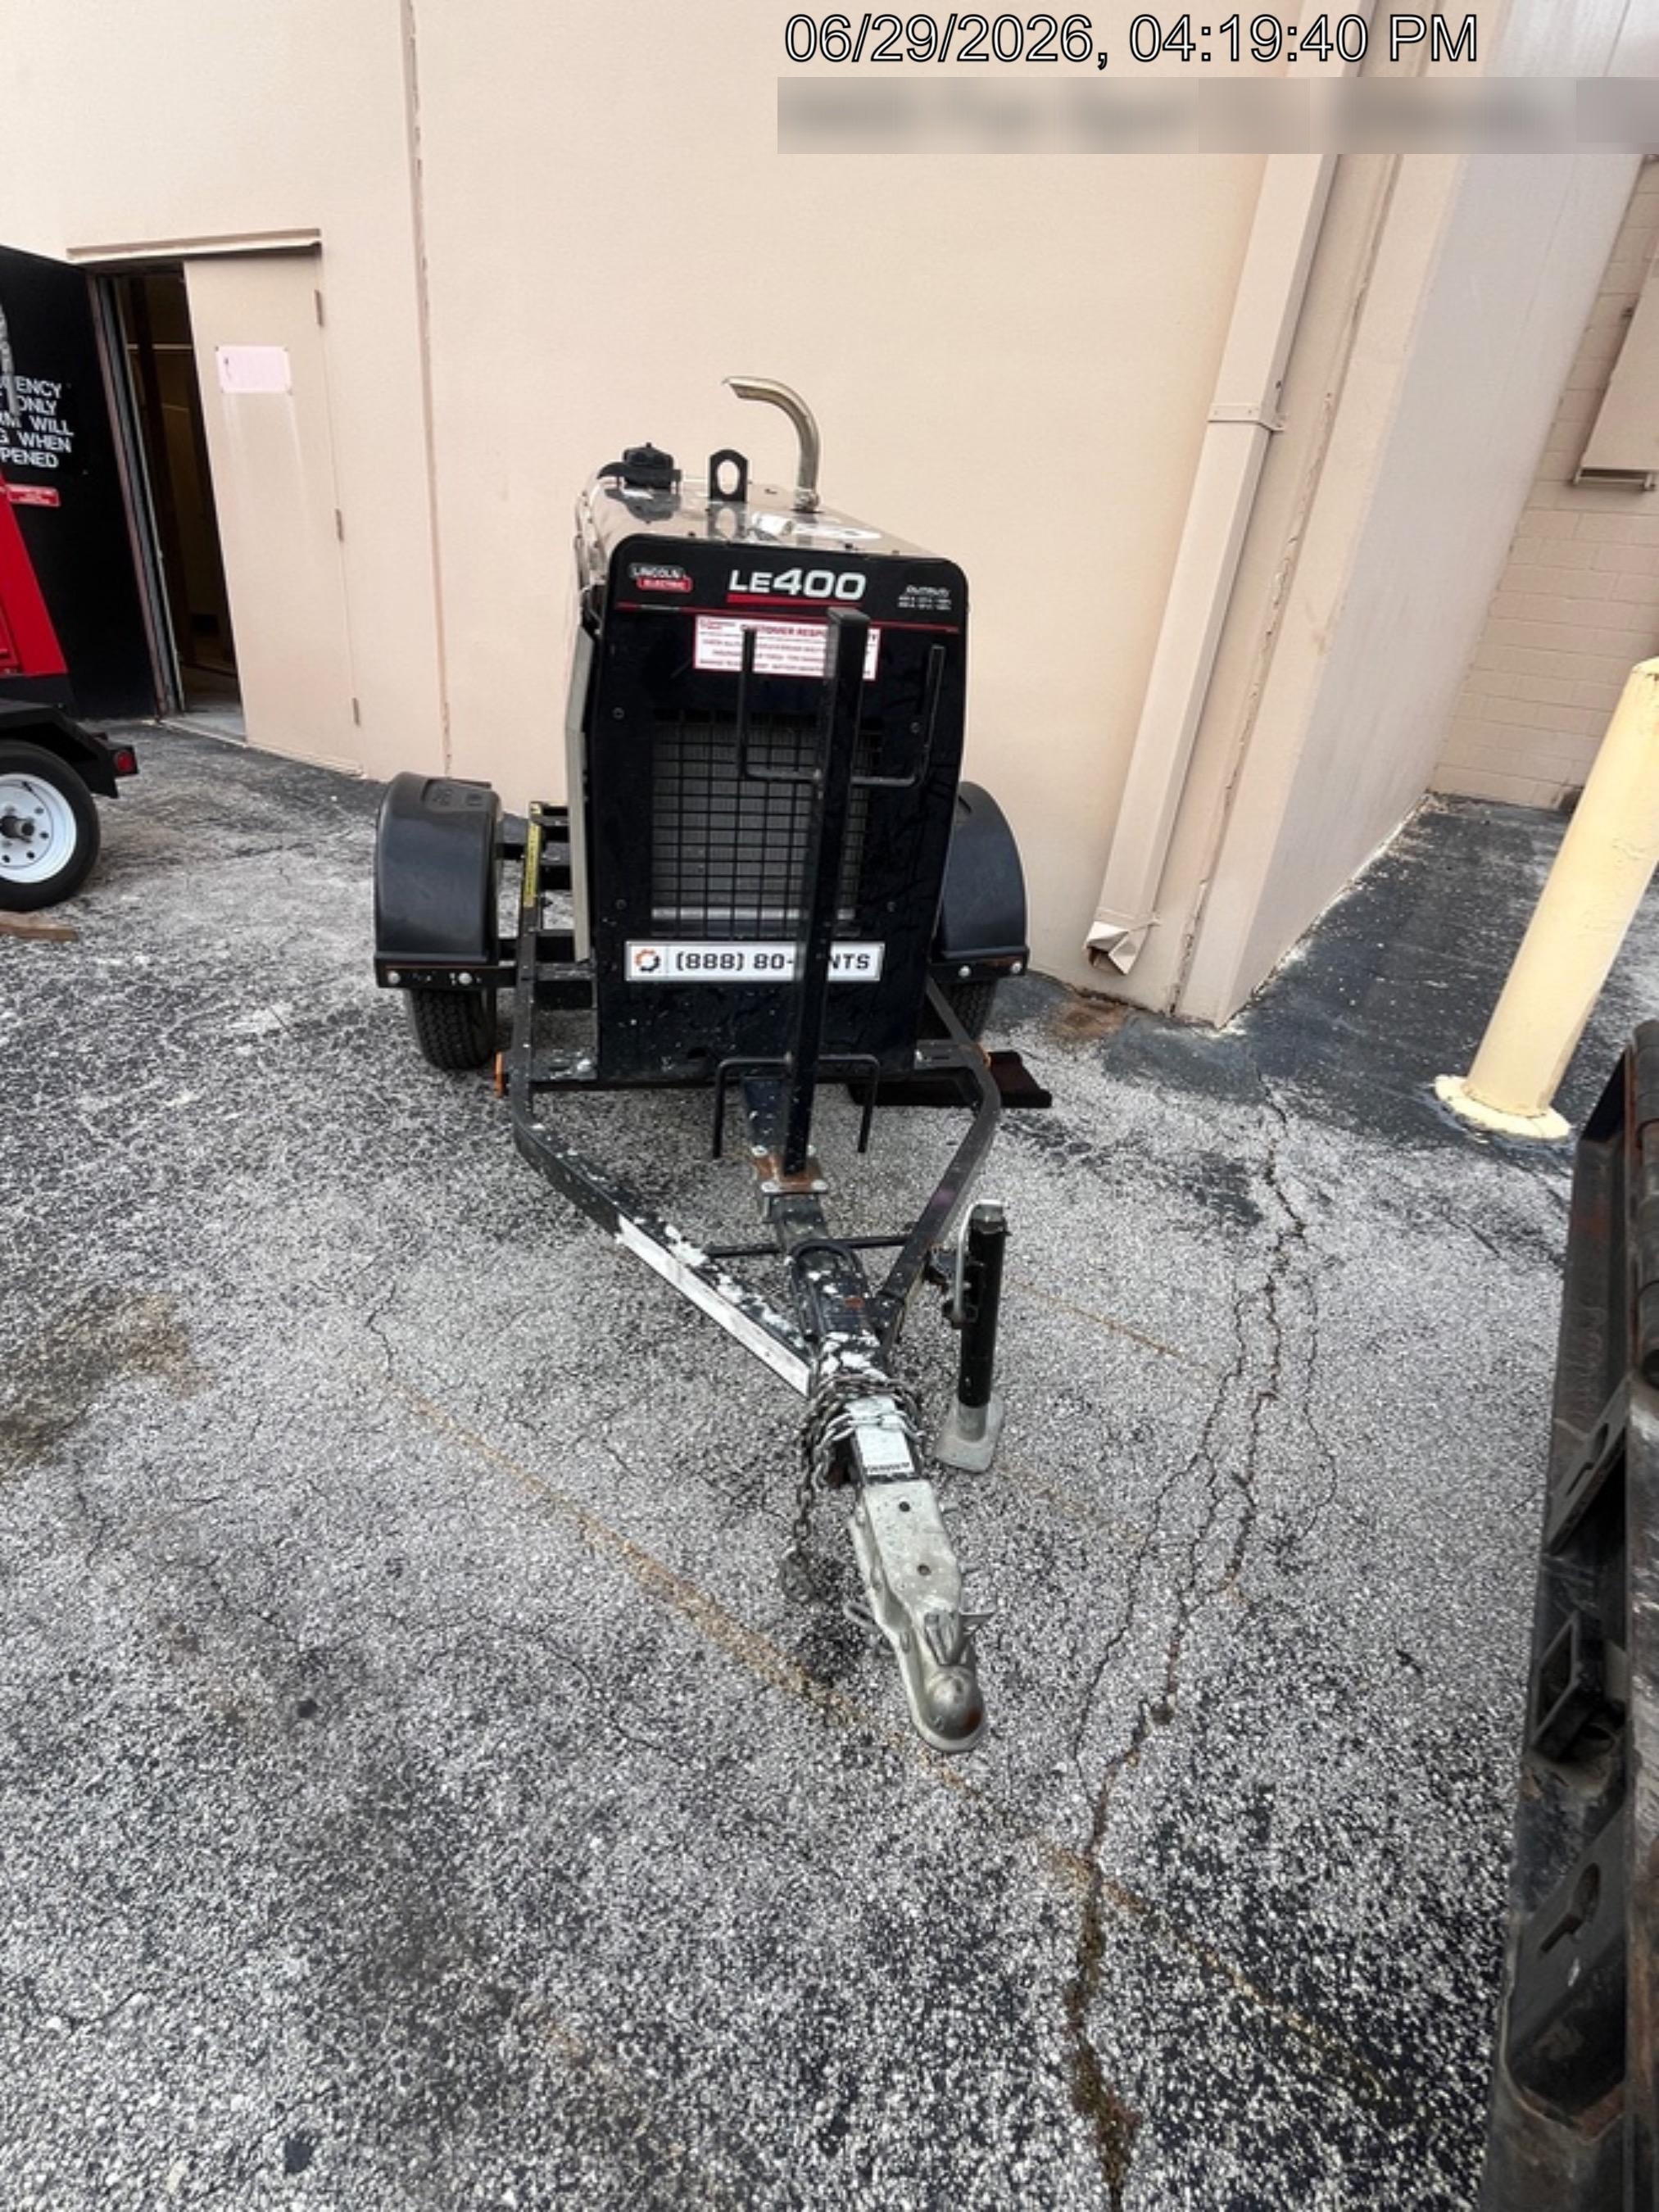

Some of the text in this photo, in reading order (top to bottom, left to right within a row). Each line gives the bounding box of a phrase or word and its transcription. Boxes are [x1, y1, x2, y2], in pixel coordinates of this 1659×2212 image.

[29, 415, 75, 437] WILL
[16, 430, 72, 453] WHEN
[728, 567, 867, 601] LE400
[675, 951, 745, 972] (888)
